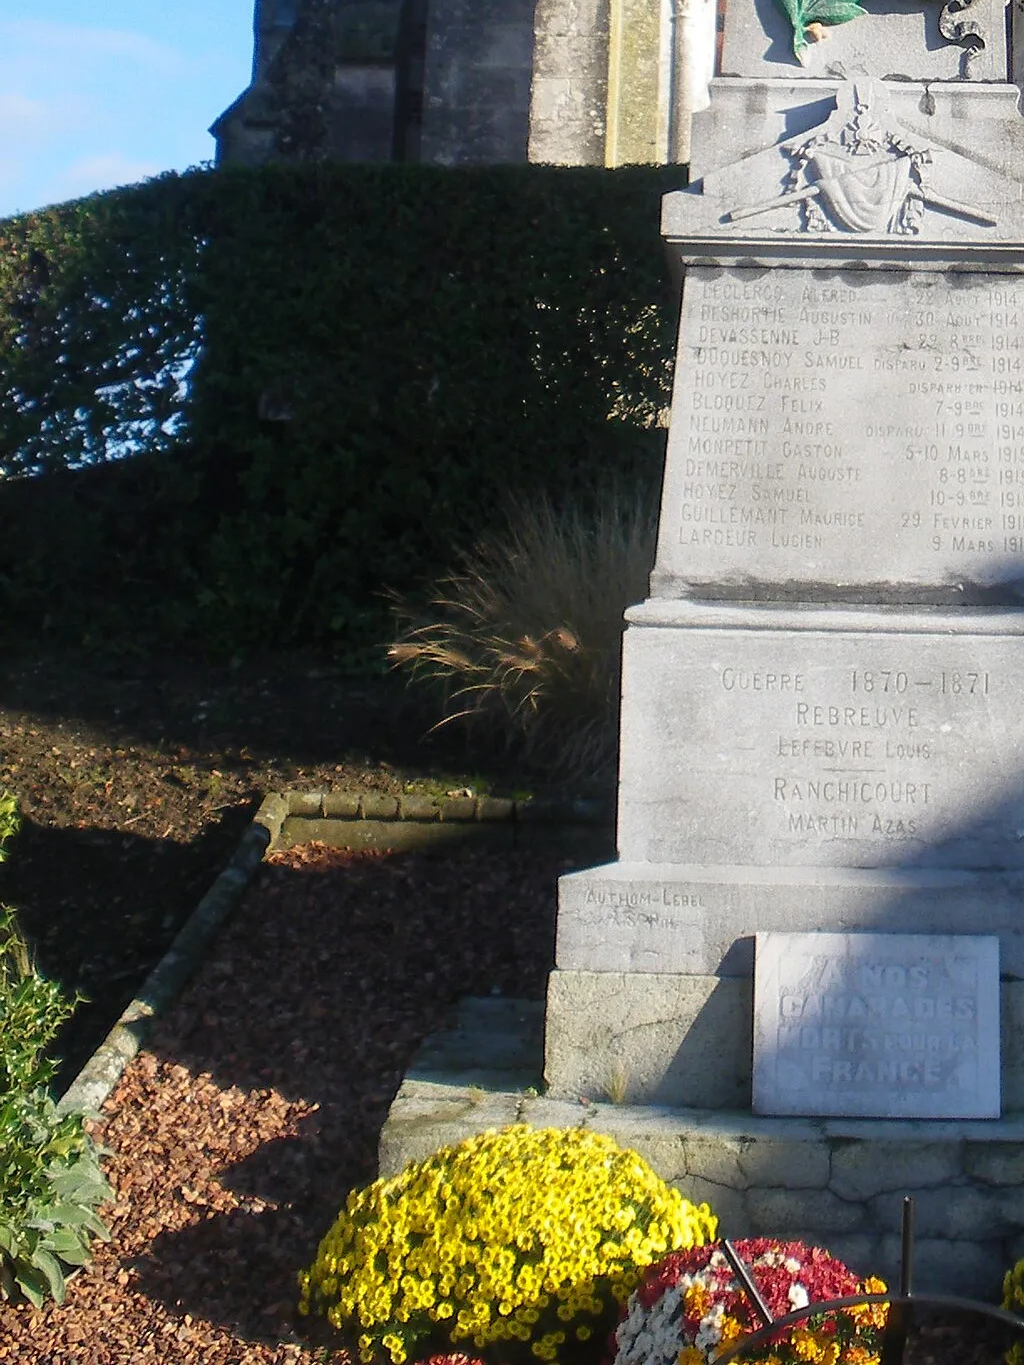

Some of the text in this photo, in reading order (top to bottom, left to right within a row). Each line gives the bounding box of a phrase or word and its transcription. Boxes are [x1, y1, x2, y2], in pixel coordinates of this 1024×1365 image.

[802, 285, 856, 303] ALFRED
[989, 291, 1017, 307] 1914
[800, 306, 872, 325] AUGUSTIN
[990, 312, 1018, 328] 1914
[699, 326, 799, 345] DEVASSENNE
[991, 335, 1020, 351] 1914
[804, 351, 864, 370] SAMUEL
[874, 358, 926, 371] DISPARU
[992, 358, 1021, 373] 1914
[695, 369, 749, 389] HOYEZ
[763, 371, 826, 391] CHARLES
[993, 380, 1023, 395] 1914
[693, 392, 765, 412] BLOQUEZ
[780, 395, 824, 413] FELIX
[995, 402, 1024, 417] 1914
[690, 415, 769, 433] NEUMANN
[997, 425, 1024, 440] 1914
[688, 437, 768, 456] MONPETIT
[782, 441, 842, 459] GASTON
[947, 445, 989, 463] MARS
[686, 458, 785, 480] DEMERVILLE
[798, 463, 861, 482] AUGUSTE
[683, 483, 737, 501] HOYEZ
[751, 484, 811, 503] SAMUEL
[681, 503, 788, 524] GUILLEMANT
[800, 508, 865, 528] MAURICE
[934, 513, 993, 530] FEVRIER
[679, 526, 757, 546] LARDEUR
[771, 529, 823, 548] LUCIEN
[952, 536, 994, 552] MARS
[721, 668, 805, 692] GUERRE
[796, 702, 919, 728] REBREUVE
[777, 737, 932, 759] LEFEBVRE LOUIS
[774, 777, 932, 804] RANCHICOURT
[788, 814, 858, 835] MARTIN
[861, 965, 929, 990] NOS
[780, 996, 976, 1020] CAMARADES
[884, 1034, 940, 1051] POUR
[812, 1056, 942, 1082] FRANCE
